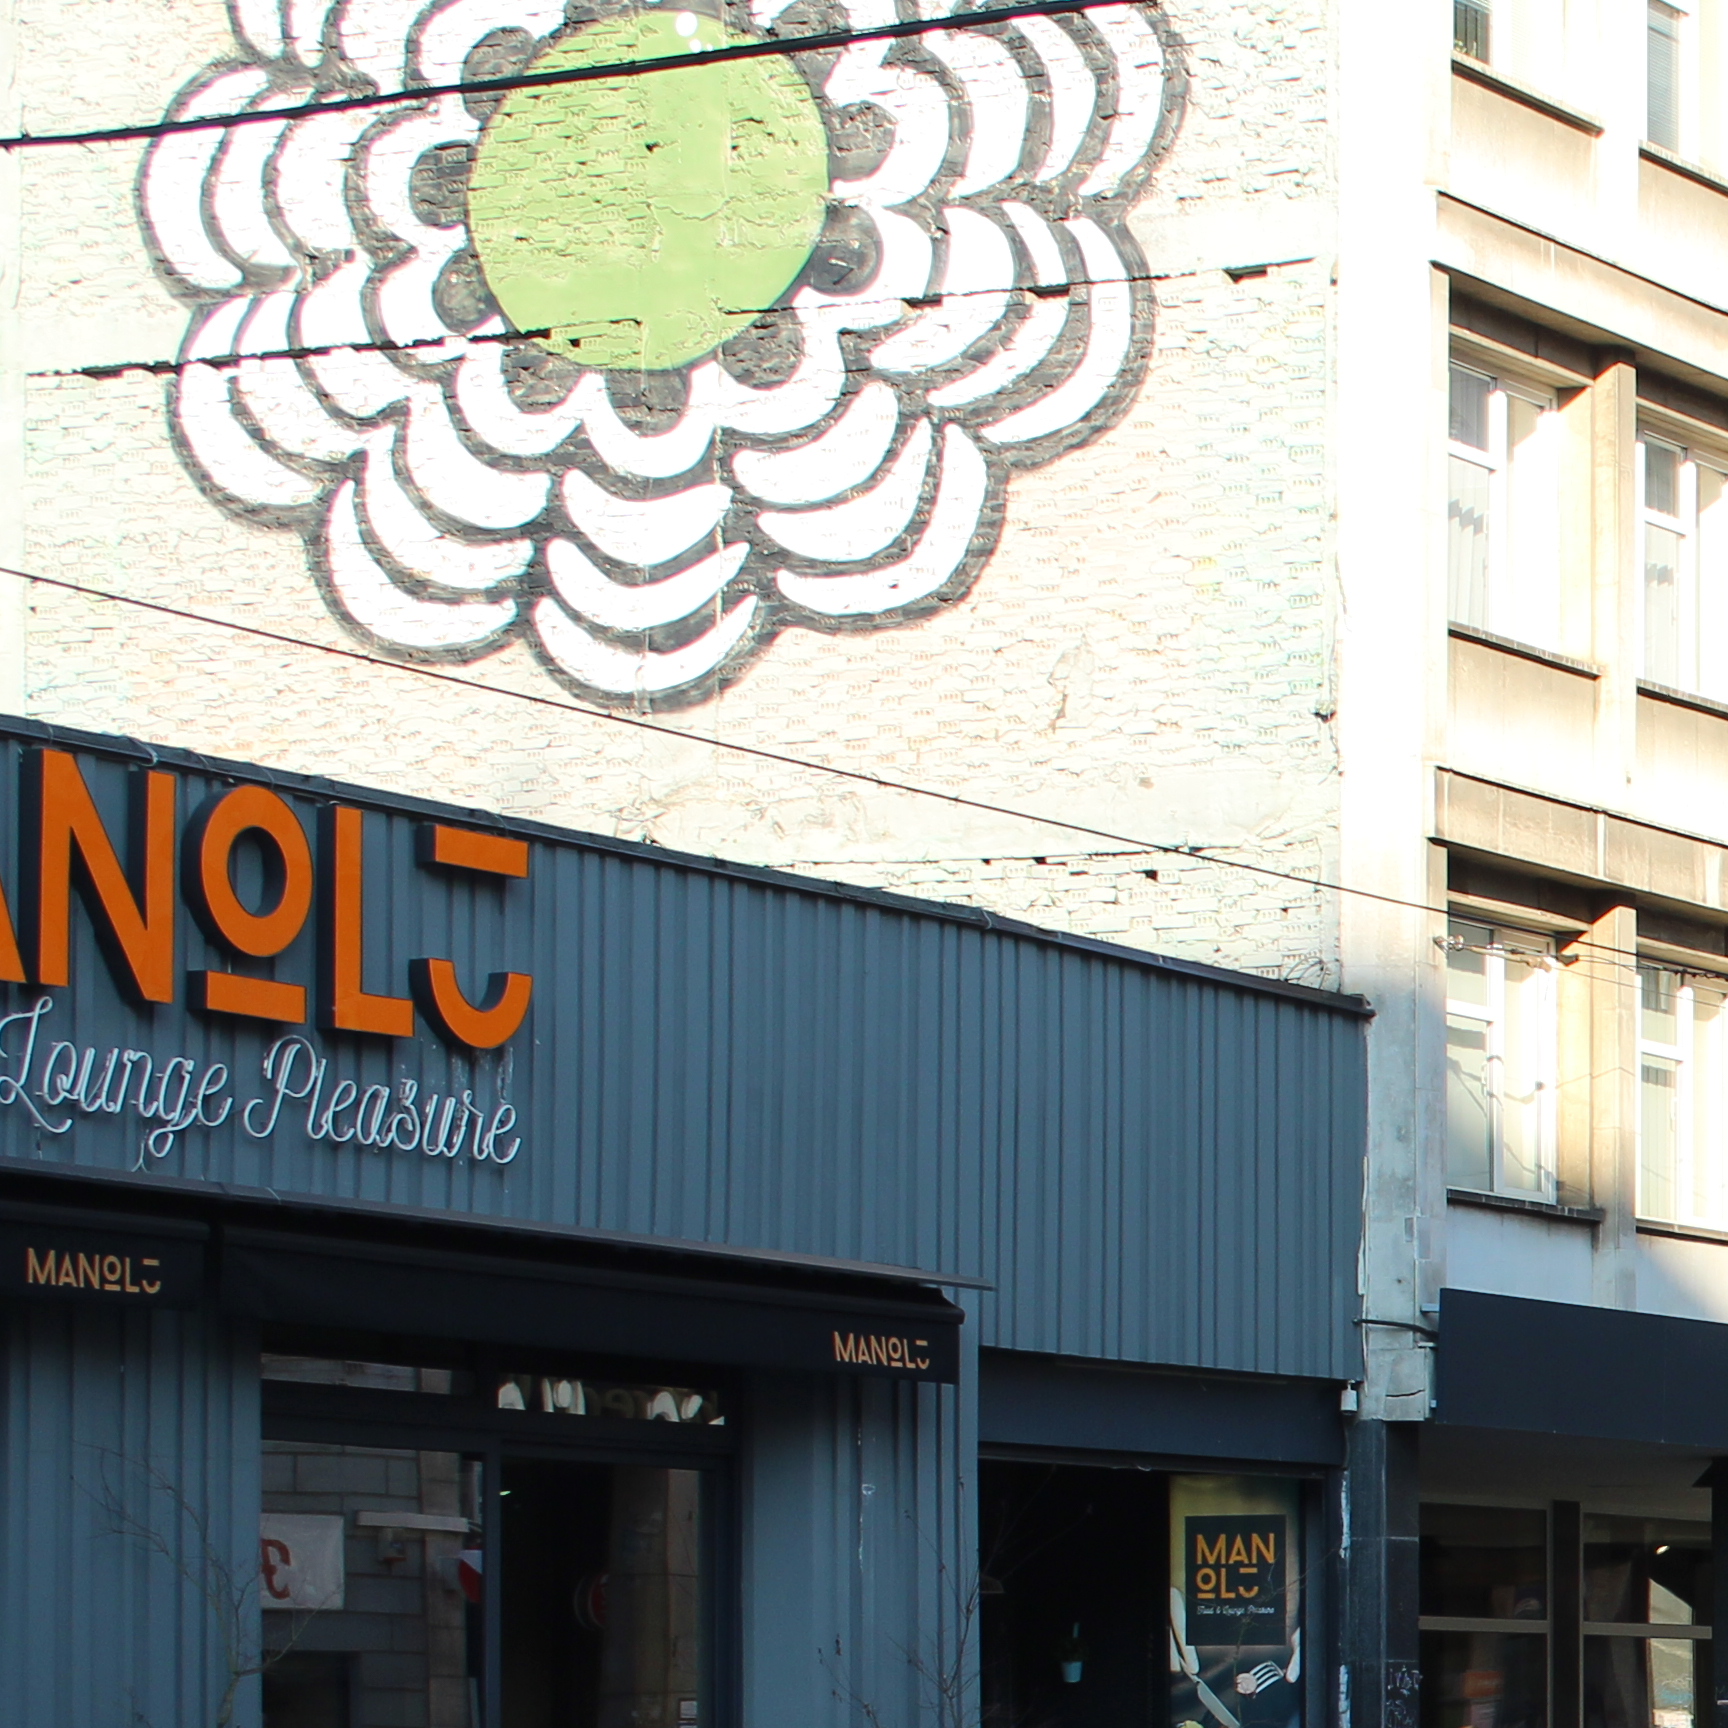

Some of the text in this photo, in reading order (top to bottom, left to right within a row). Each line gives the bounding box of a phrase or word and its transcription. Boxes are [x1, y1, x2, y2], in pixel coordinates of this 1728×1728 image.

[0, 996, 521, 1164] Lounge Pleasure
[1196, 1533, 1275, 1564] MAN
